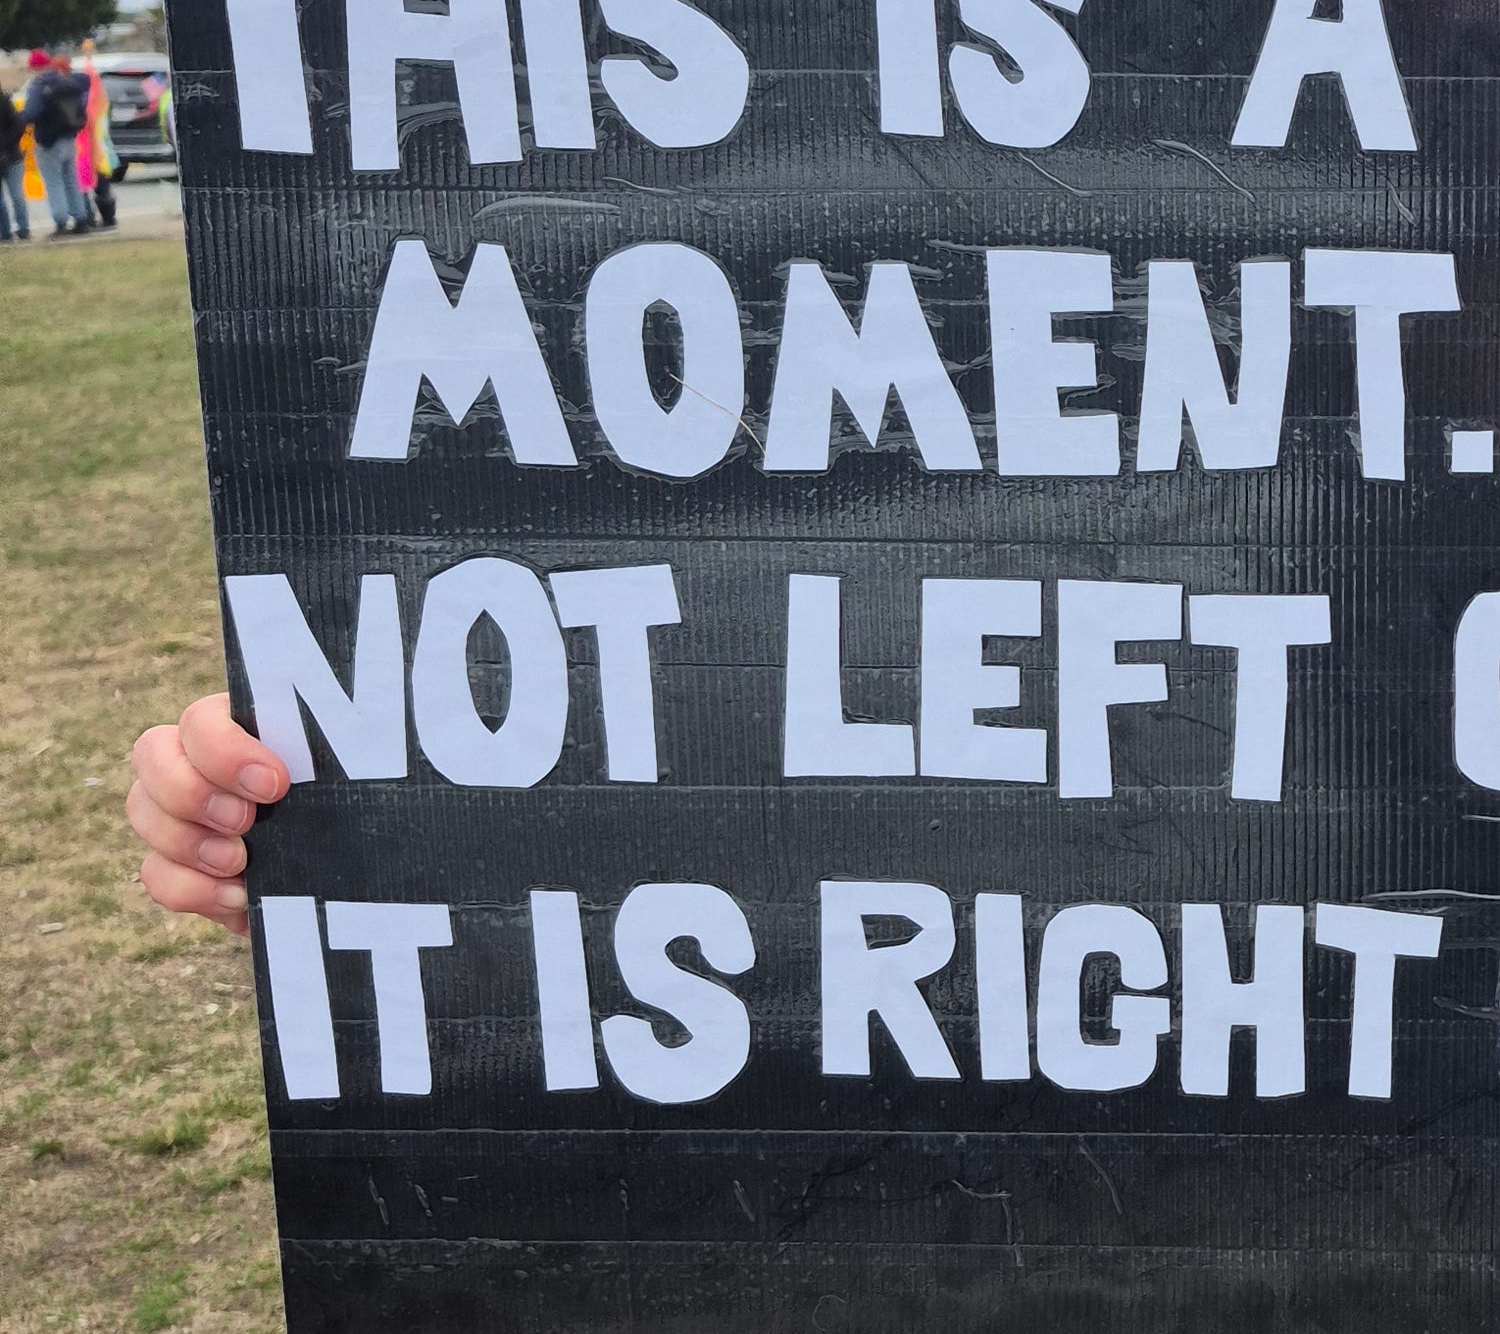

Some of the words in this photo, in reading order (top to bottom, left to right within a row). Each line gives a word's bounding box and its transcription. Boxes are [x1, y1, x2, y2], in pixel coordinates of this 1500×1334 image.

[350, 240, 1494, 483] MOMENT.
[225, 557, 682, 789] NOT
[784, 574, 1332, 802] LEFT
[261, 896, 454, 1100] IT
[530, 883, 757, 1104] IS
[820, 881, 1443, 1099] RIGHT
